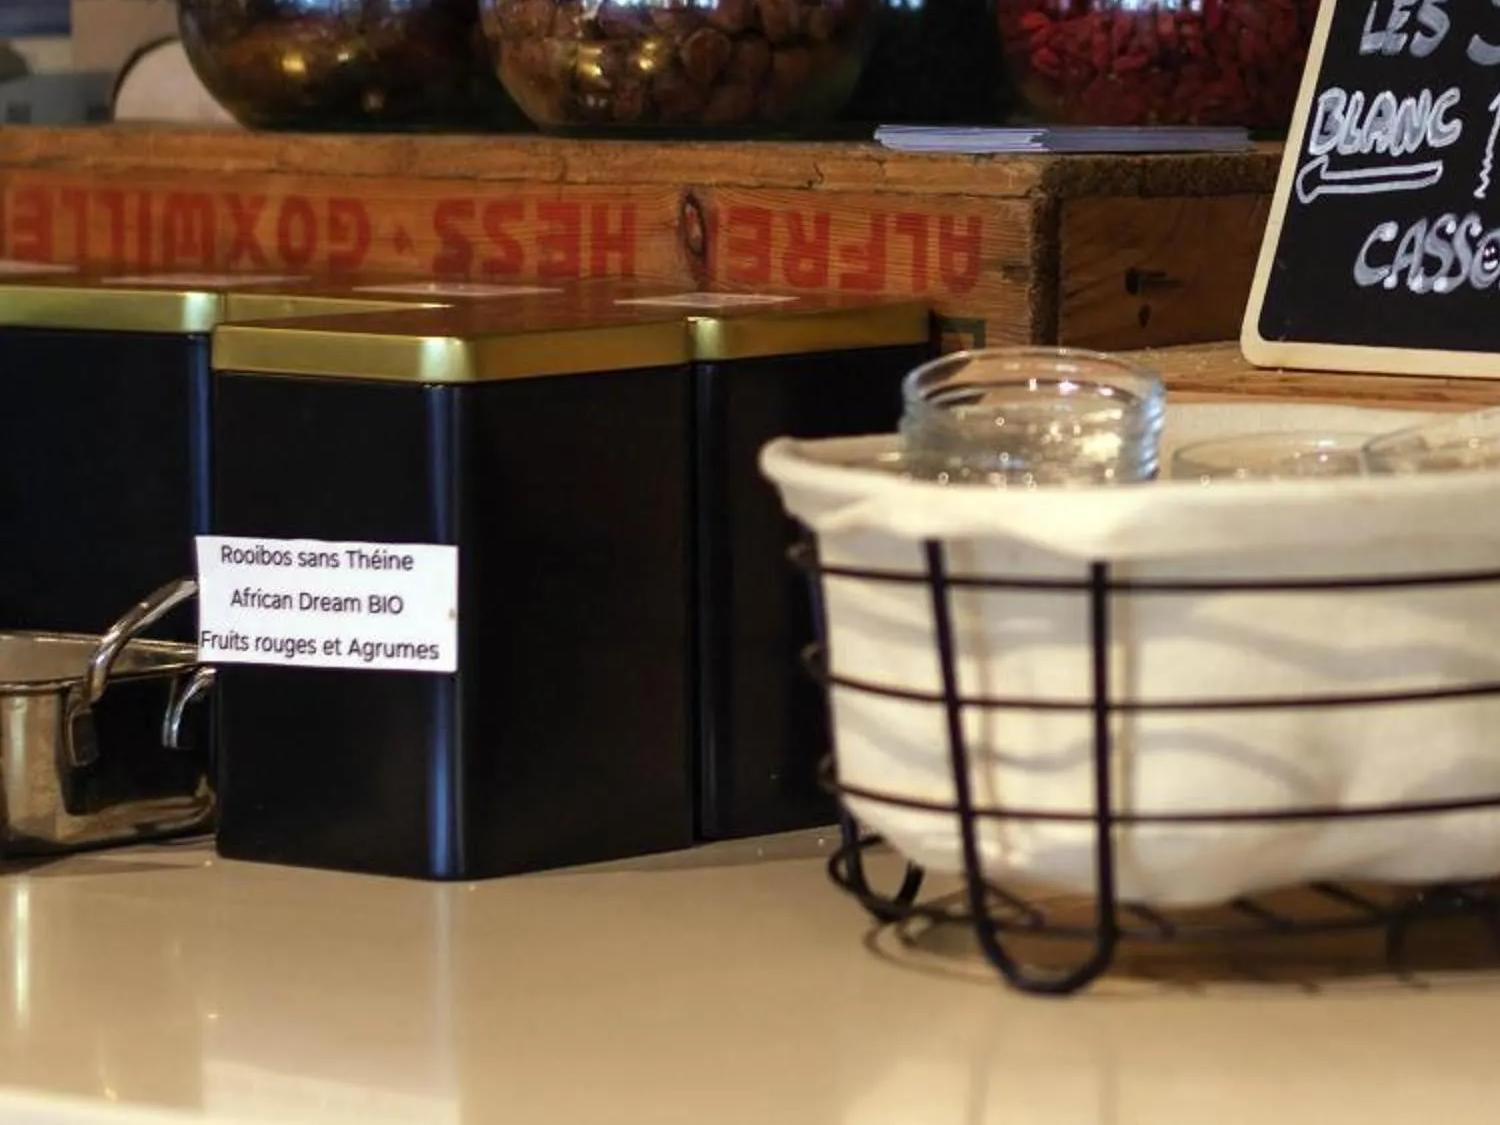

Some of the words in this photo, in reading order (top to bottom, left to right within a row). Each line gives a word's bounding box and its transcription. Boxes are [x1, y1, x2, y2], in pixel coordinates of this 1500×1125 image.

[1308, 86, 1463, 156] BLANC
[0, 187, 372, 274] GOXWILLE
[432, 198, 638, 274] HESS
[297, 551, 340, 569] sans
[345, 548, 415, 571] Théine
[230, 586, 293, 610] African
[298, 592, 361, 613] Dream
[368, 594, 405, 615] BIO
[200, 630, 250, 652] Fruits
[254, 635, 317, 659] rouges
[322, 637, 343, 656] et
[346, 638, 440, 663] Agrumes
